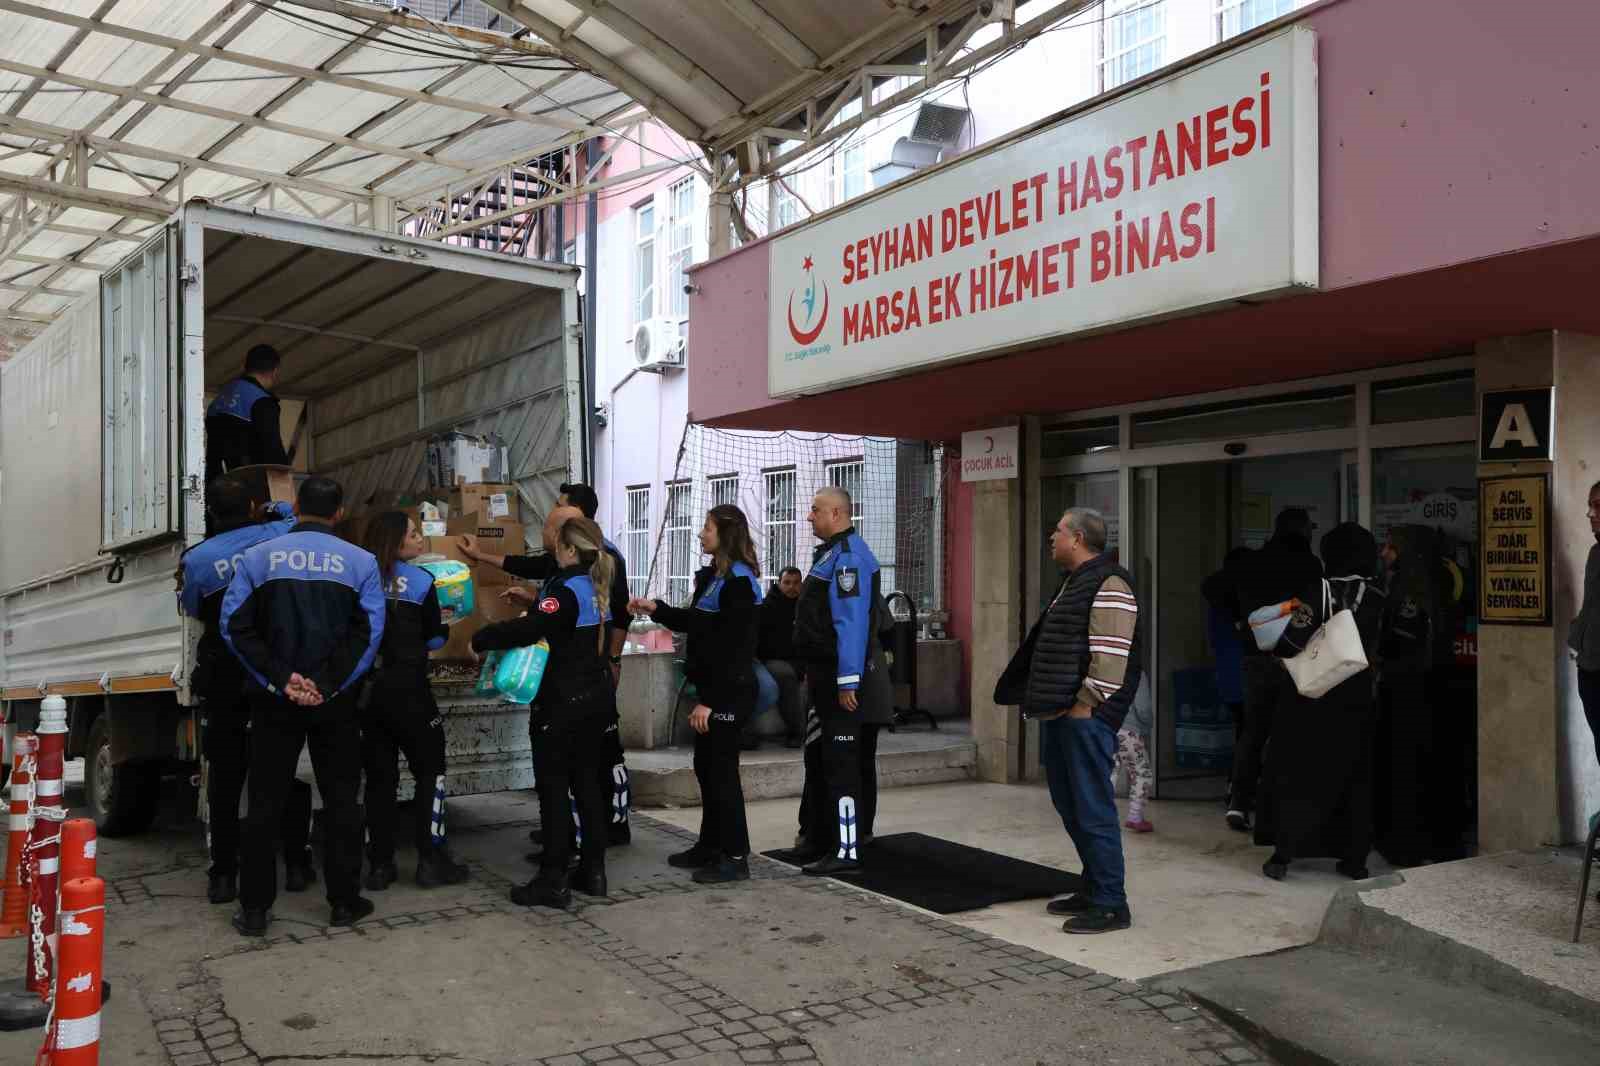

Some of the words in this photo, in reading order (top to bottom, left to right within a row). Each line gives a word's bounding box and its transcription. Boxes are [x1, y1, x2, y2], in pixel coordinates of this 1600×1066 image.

[842, 215, 933, 285] SEYHAN
[941, 174, 1047, 253] DEVLET
[1058, 71, 1271, 215] HASTANESİ
[842, 288, 922, 346] MARSA
[928, 273, 961, 324] EK
[970, 238, 1081, 313] HİZMET
[1091, 197, 1216, 283] BİNASI
[1488, 403, 1540, 449] A
[1423, 498, 1457, 521] GİRİŞ
[1499, 490, 1526, 506] ACİL
[1490, 577, 1536, 592] YATAKLI
